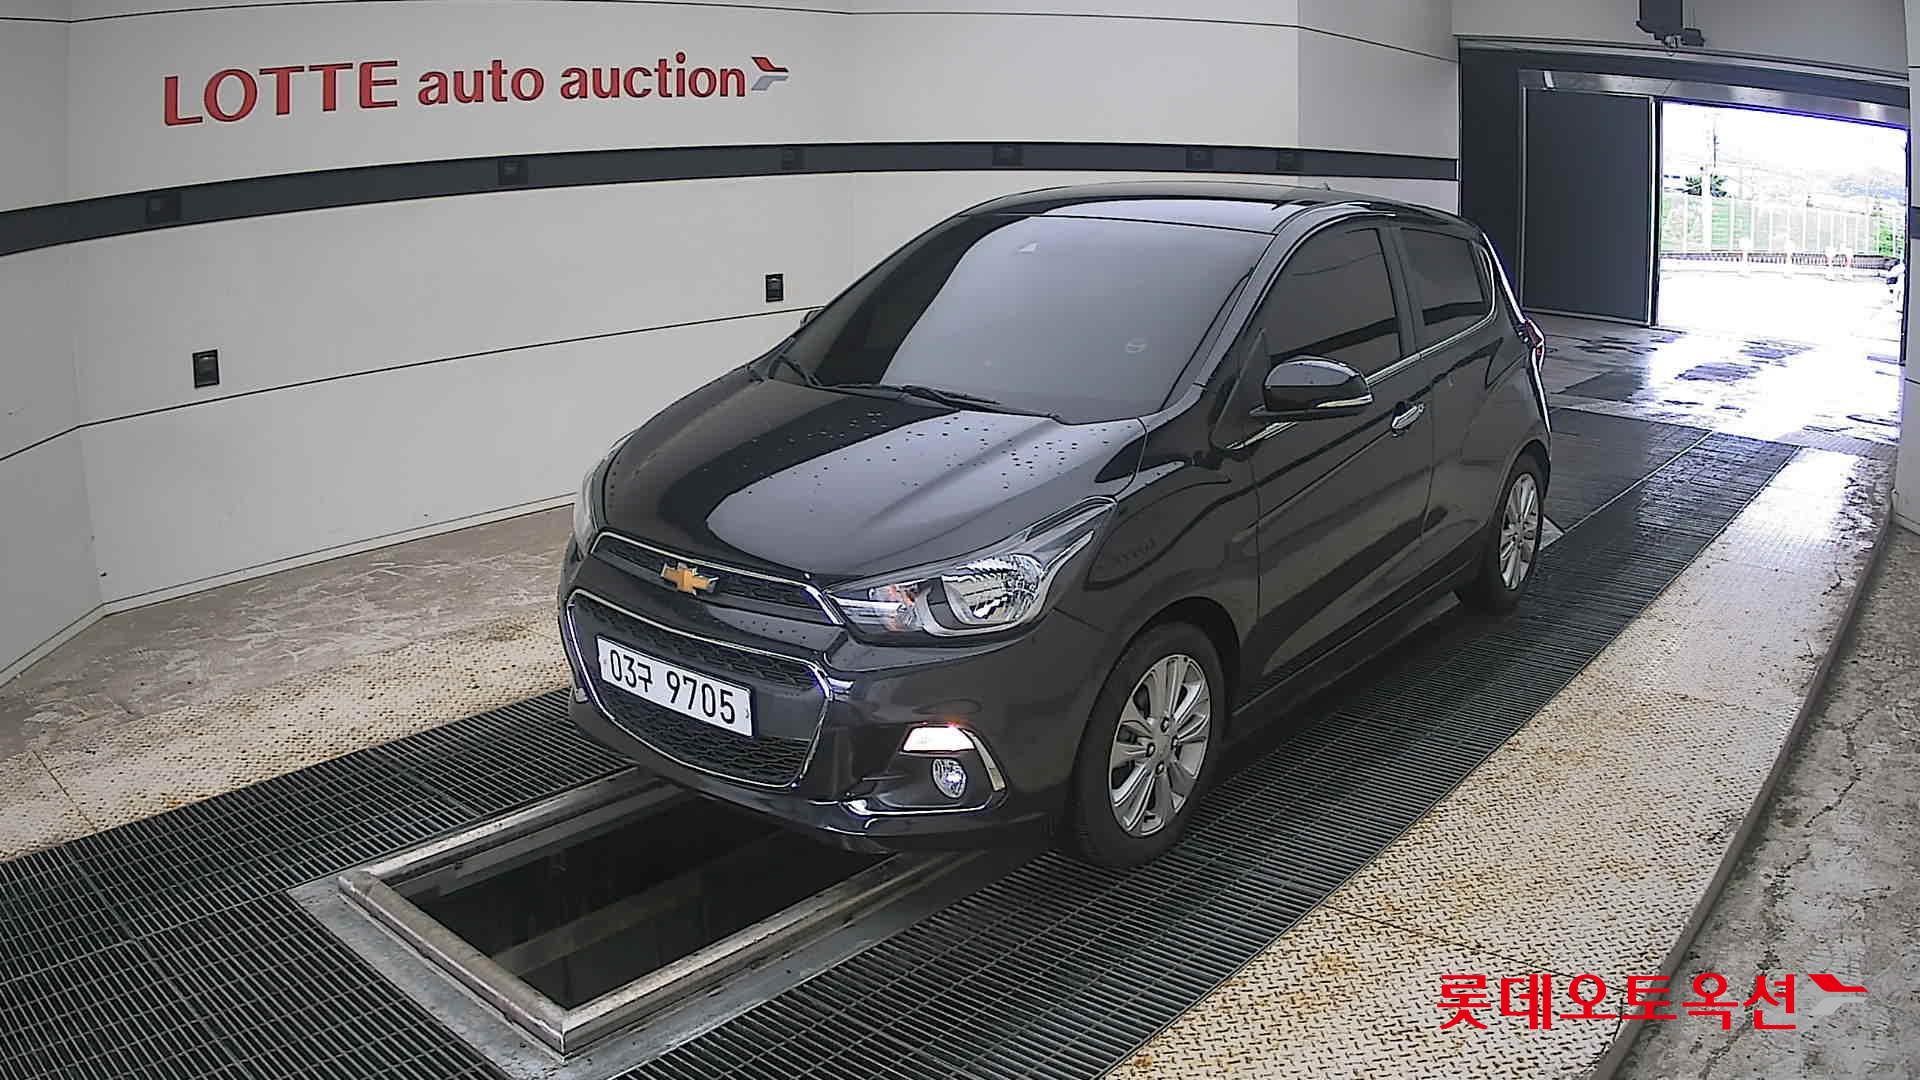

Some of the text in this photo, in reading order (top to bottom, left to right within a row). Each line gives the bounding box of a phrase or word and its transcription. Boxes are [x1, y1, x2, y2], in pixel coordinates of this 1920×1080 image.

[163, 51, 747, 127] LOTTE auto auction
[609, 649, 736, 725] 03구 9705
